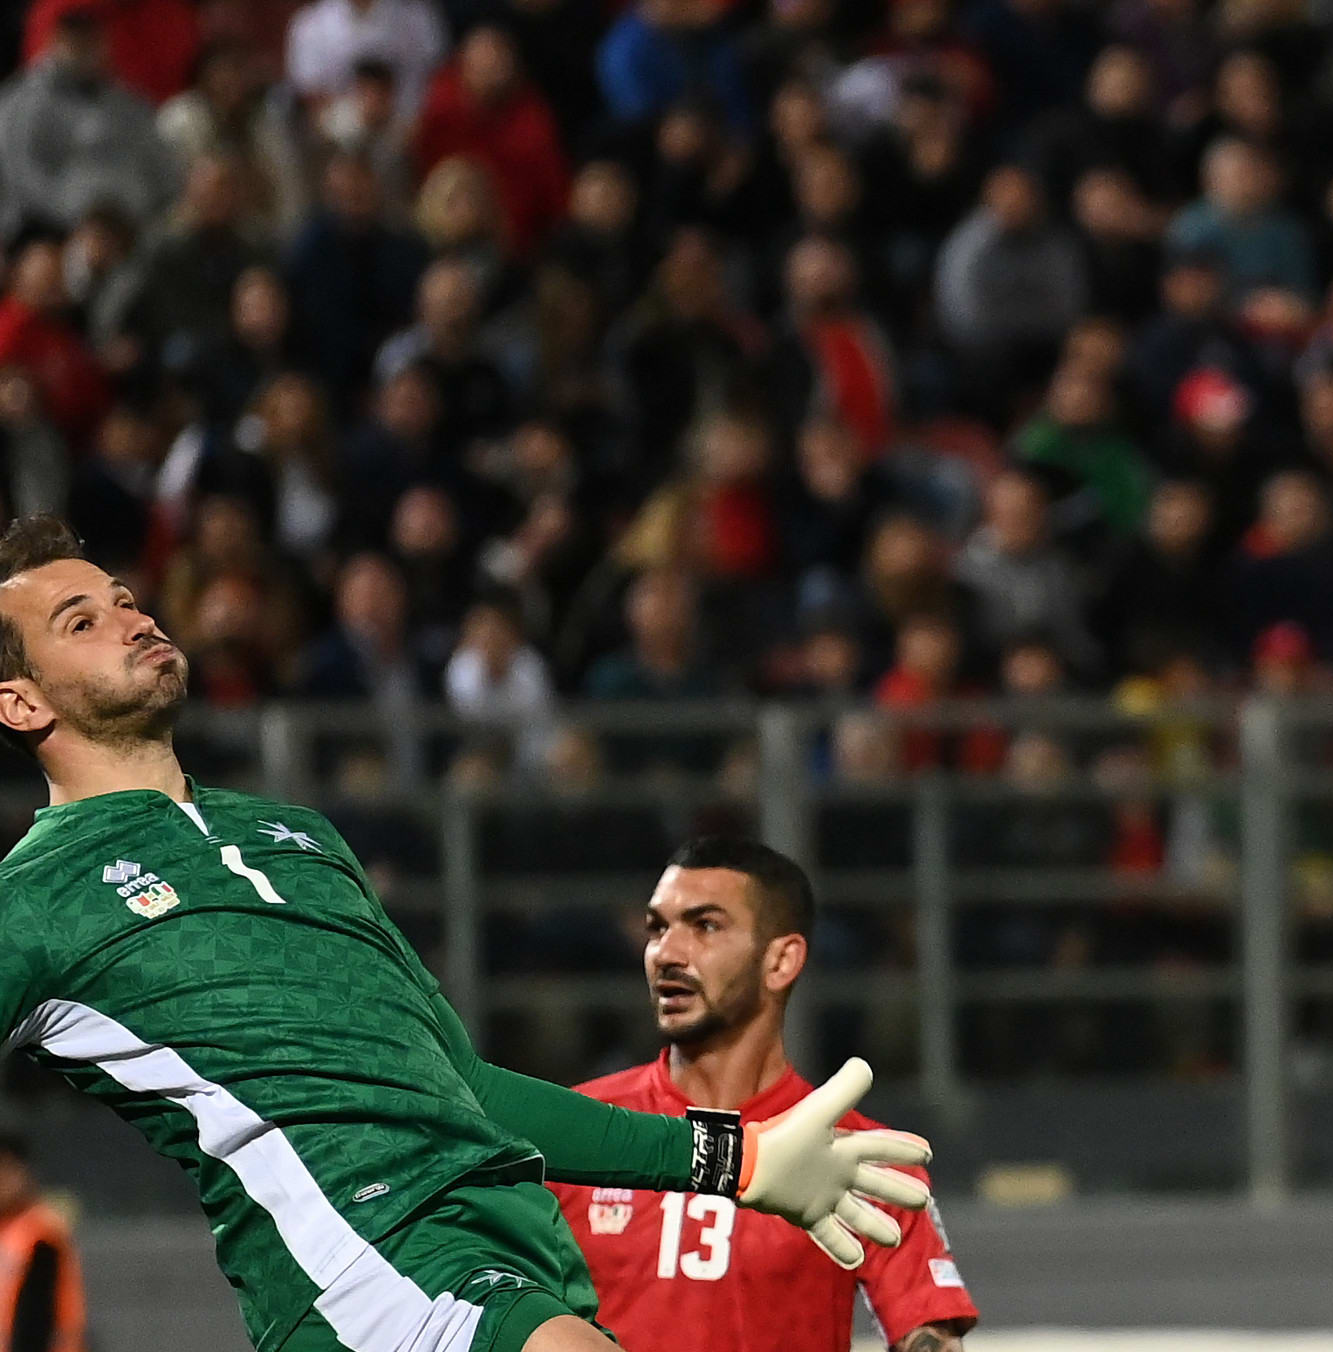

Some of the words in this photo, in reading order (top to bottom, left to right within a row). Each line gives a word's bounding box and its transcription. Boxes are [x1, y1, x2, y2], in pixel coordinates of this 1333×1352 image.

[115, 872, 160, 898] errea
[219, 844, 288, 904] 1
[656, 1191, 737, 1282] 13
